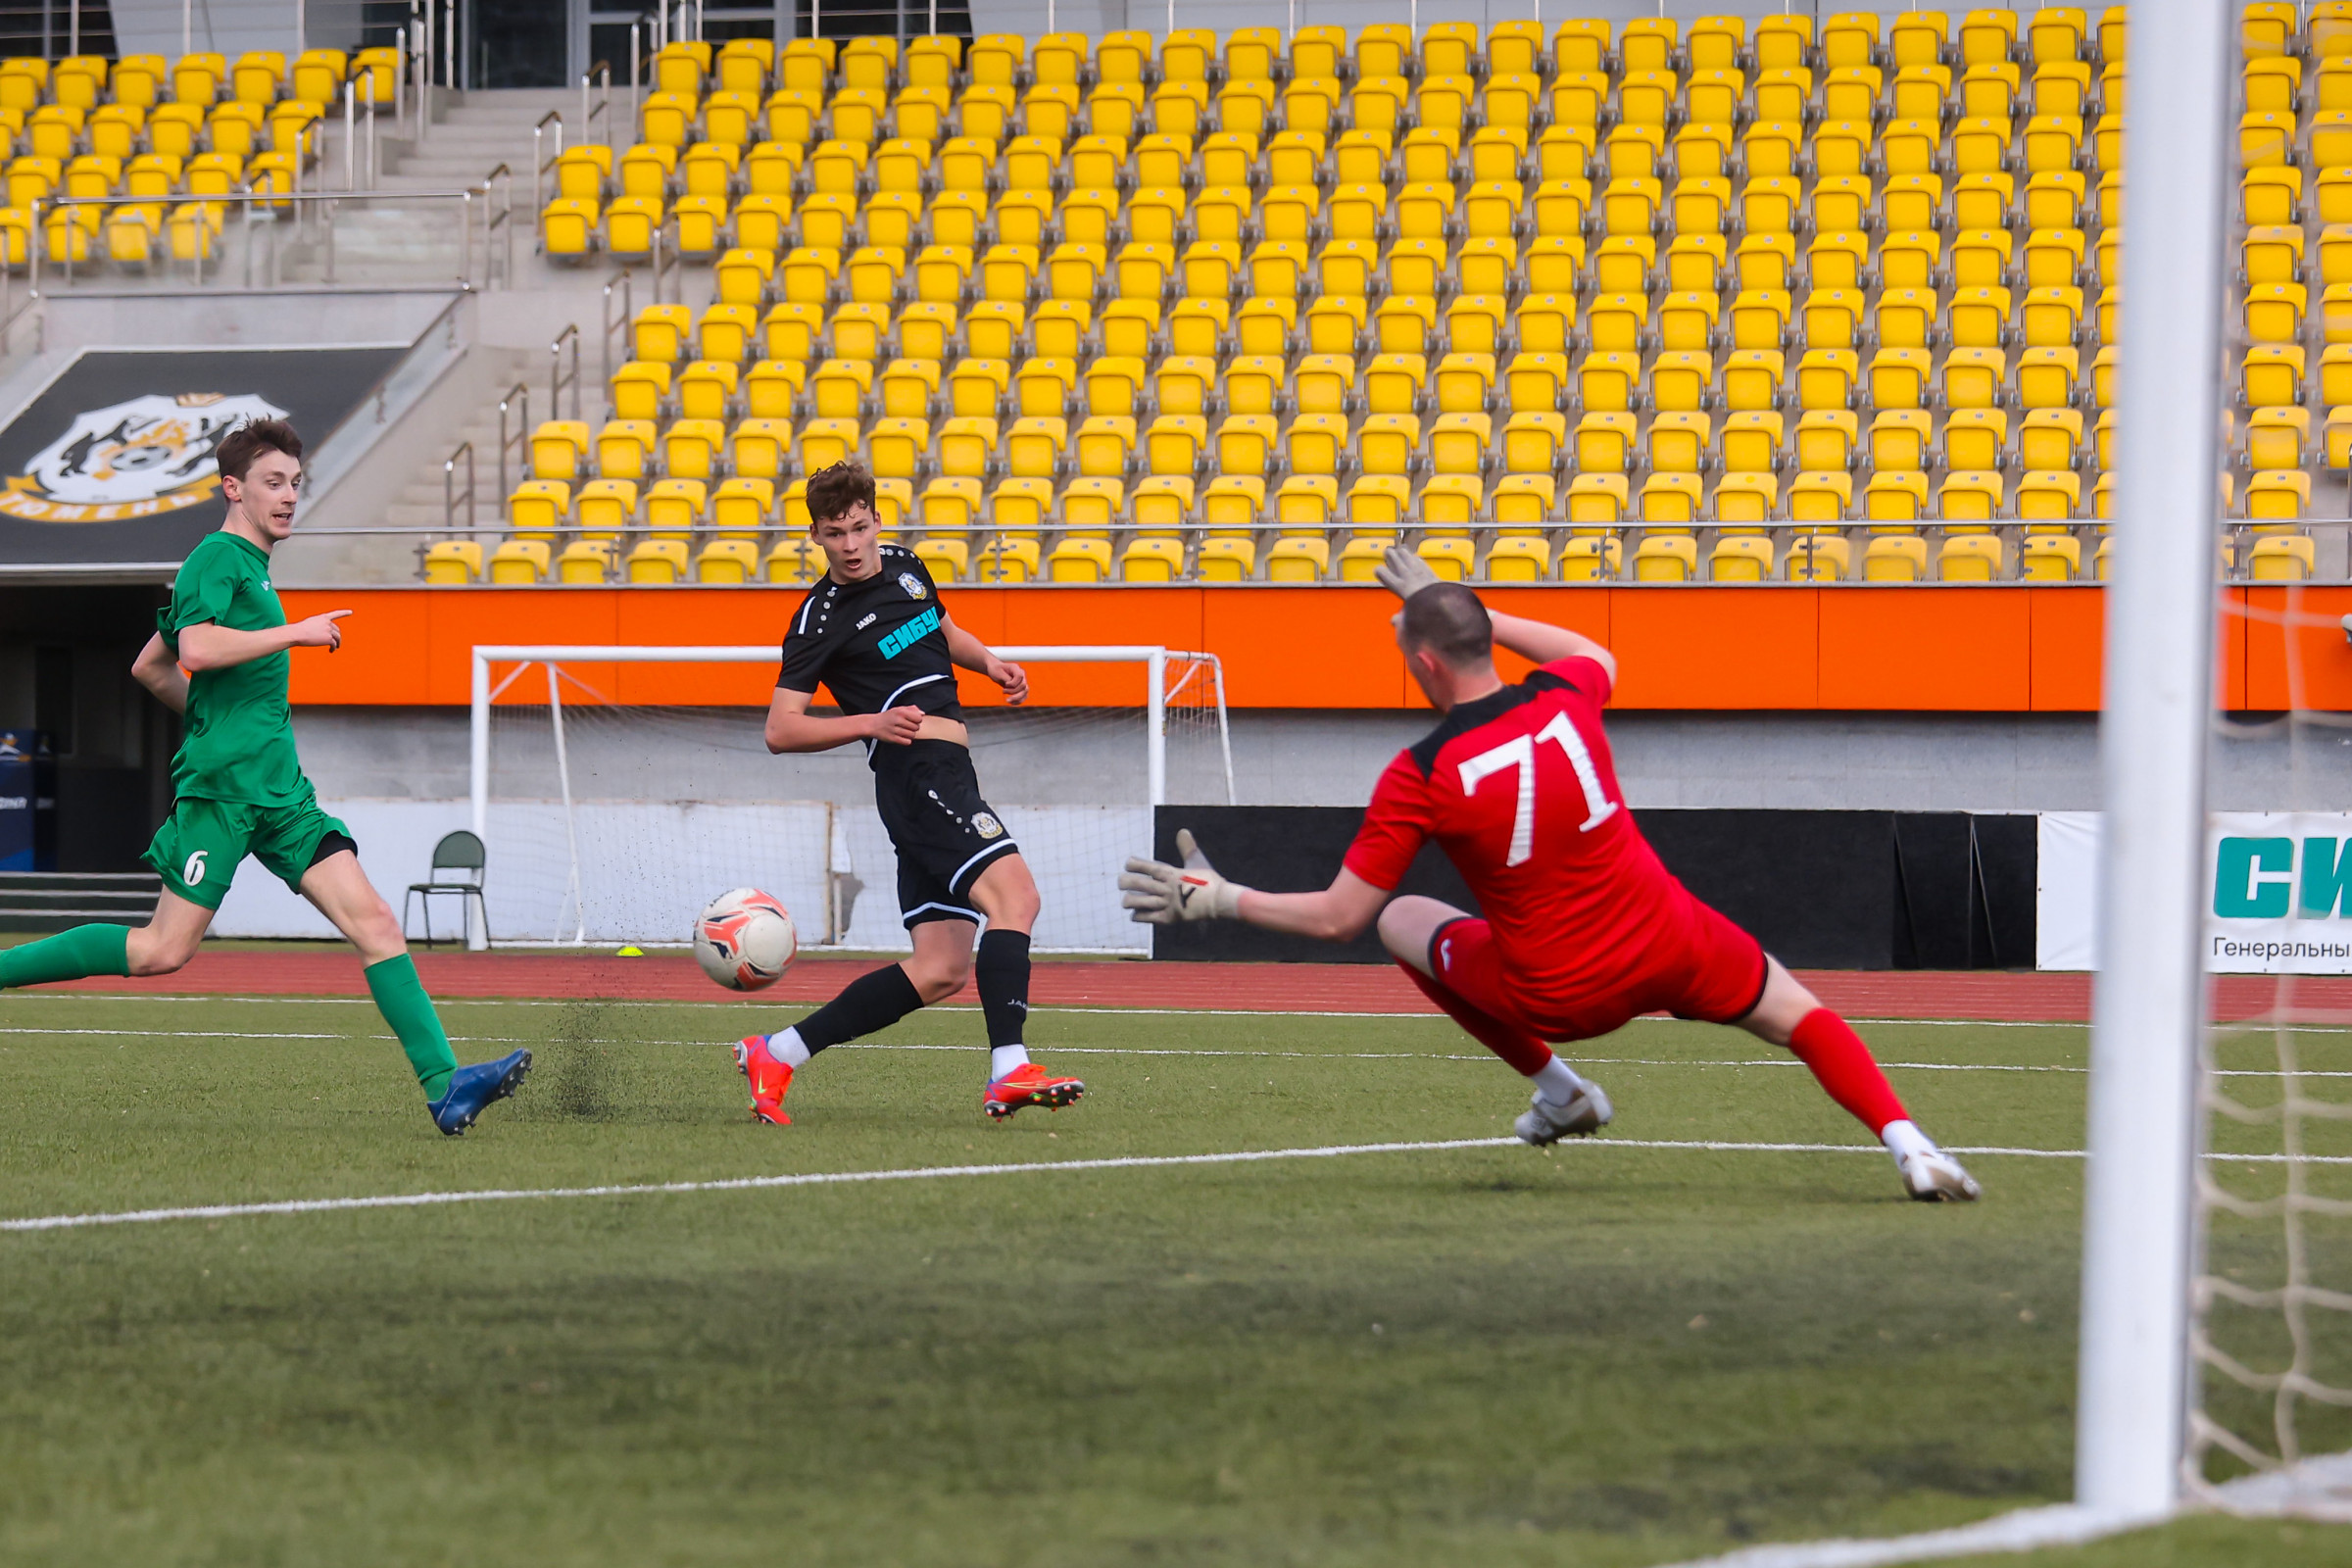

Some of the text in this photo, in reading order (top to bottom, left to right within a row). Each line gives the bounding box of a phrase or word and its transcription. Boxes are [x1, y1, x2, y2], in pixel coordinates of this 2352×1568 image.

[856, 612, 877, 630] JAKO
[877, 606, 941, 661] СИБУ
[1457, 710, 1619, 867] 71
[183, 850, 209, 887] 6
[2213, 937, 2350, 961] Генеральны
